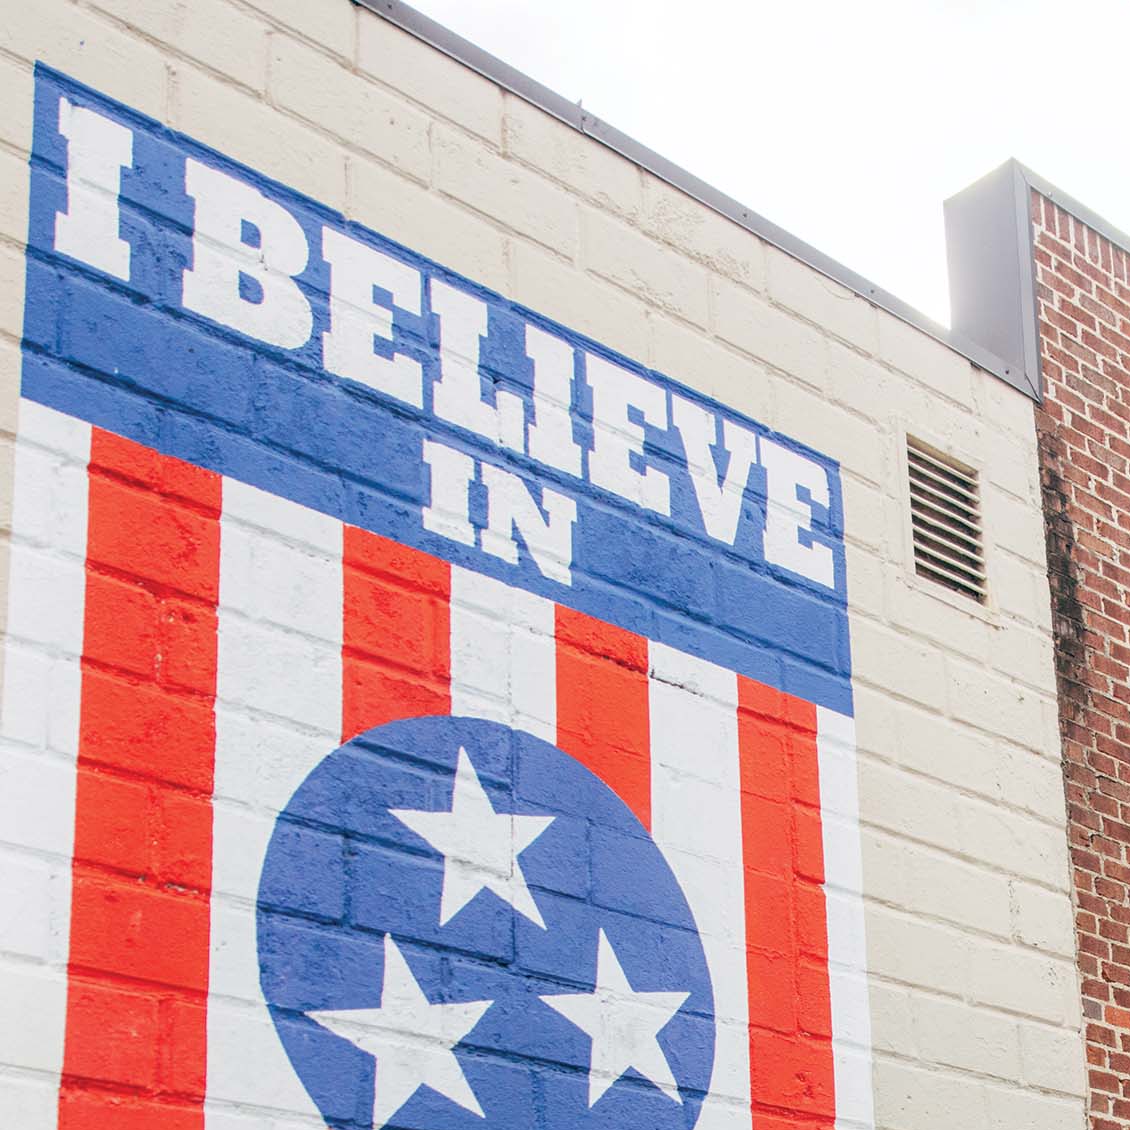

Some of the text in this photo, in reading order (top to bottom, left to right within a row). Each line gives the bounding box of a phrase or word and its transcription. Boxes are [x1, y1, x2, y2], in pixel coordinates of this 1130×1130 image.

[53, 95, 836, 591] I BELIEVE
[420, 438, 578, 587] IN
